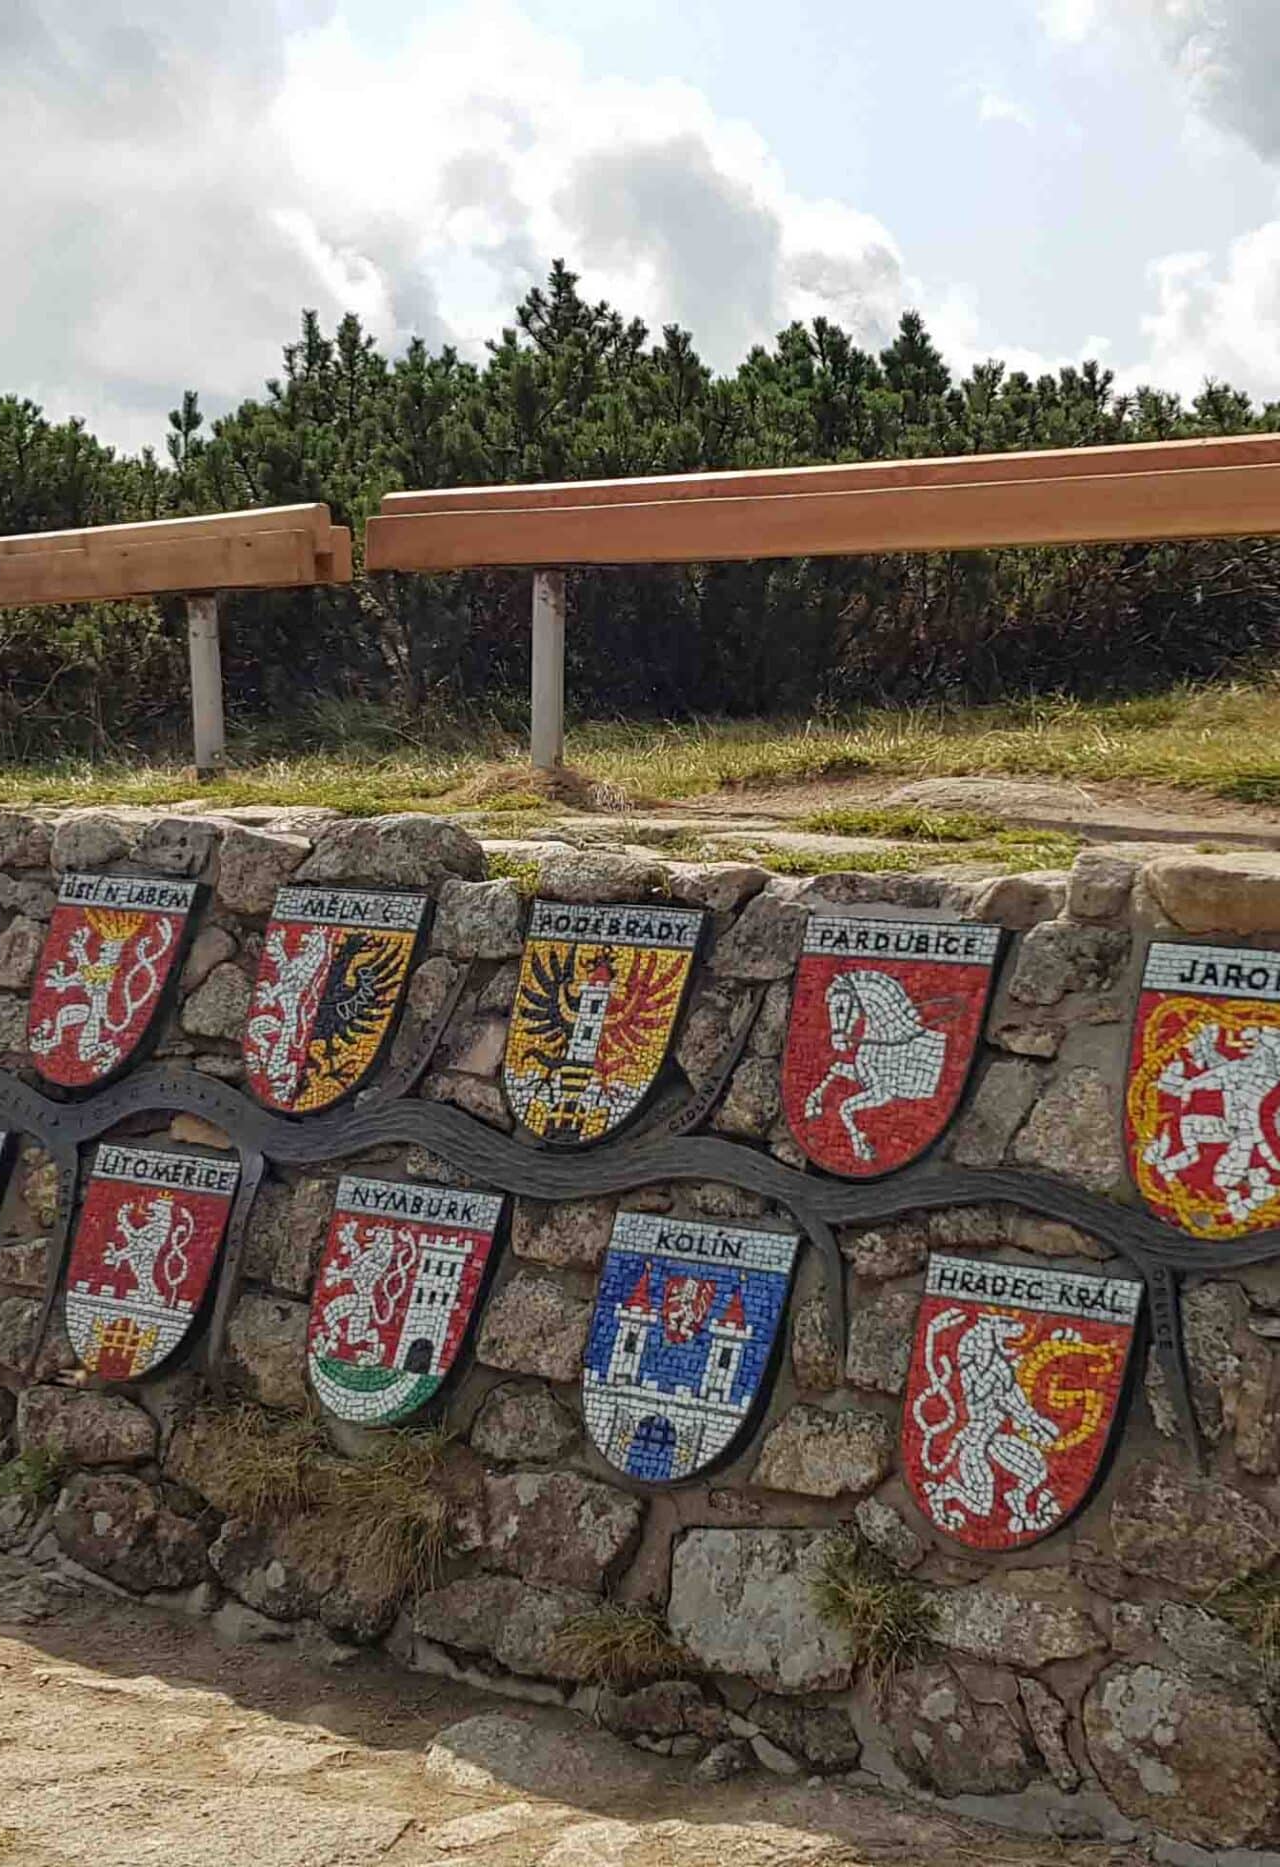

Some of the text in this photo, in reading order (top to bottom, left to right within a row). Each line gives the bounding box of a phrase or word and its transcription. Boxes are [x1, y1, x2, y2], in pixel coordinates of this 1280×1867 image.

[820, 928, 979, 955] PARDUBICE
[351, 1186, 477, 1223] NYMBURK
[938, 1268, 1043, 1301] HRADEC
